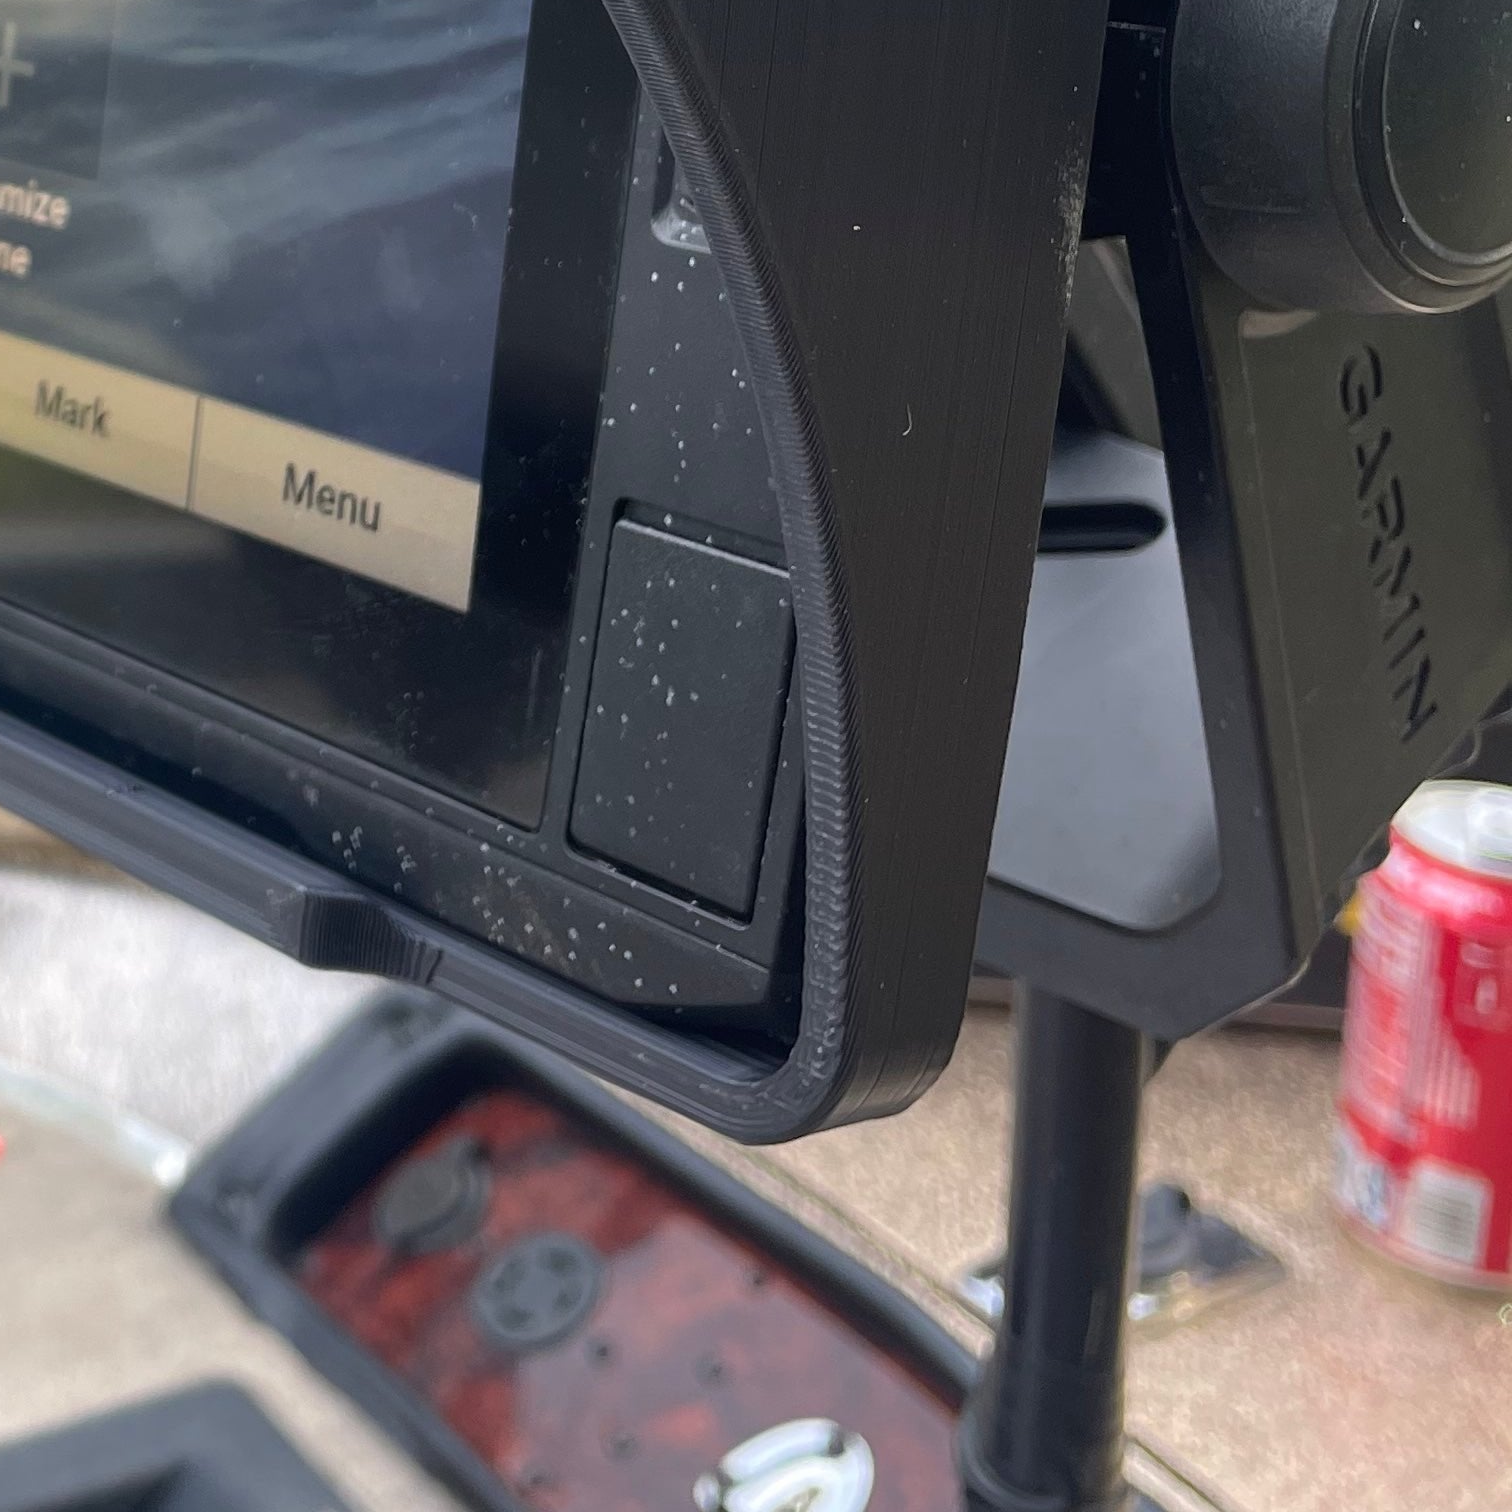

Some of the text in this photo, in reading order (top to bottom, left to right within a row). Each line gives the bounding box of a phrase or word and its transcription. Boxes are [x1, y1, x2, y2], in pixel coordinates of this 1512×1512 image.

[33, 379, 111, 438] Mark
[282, 463, 381, 532] Menu
[1340, 344, 1438, 745] GARMIN
